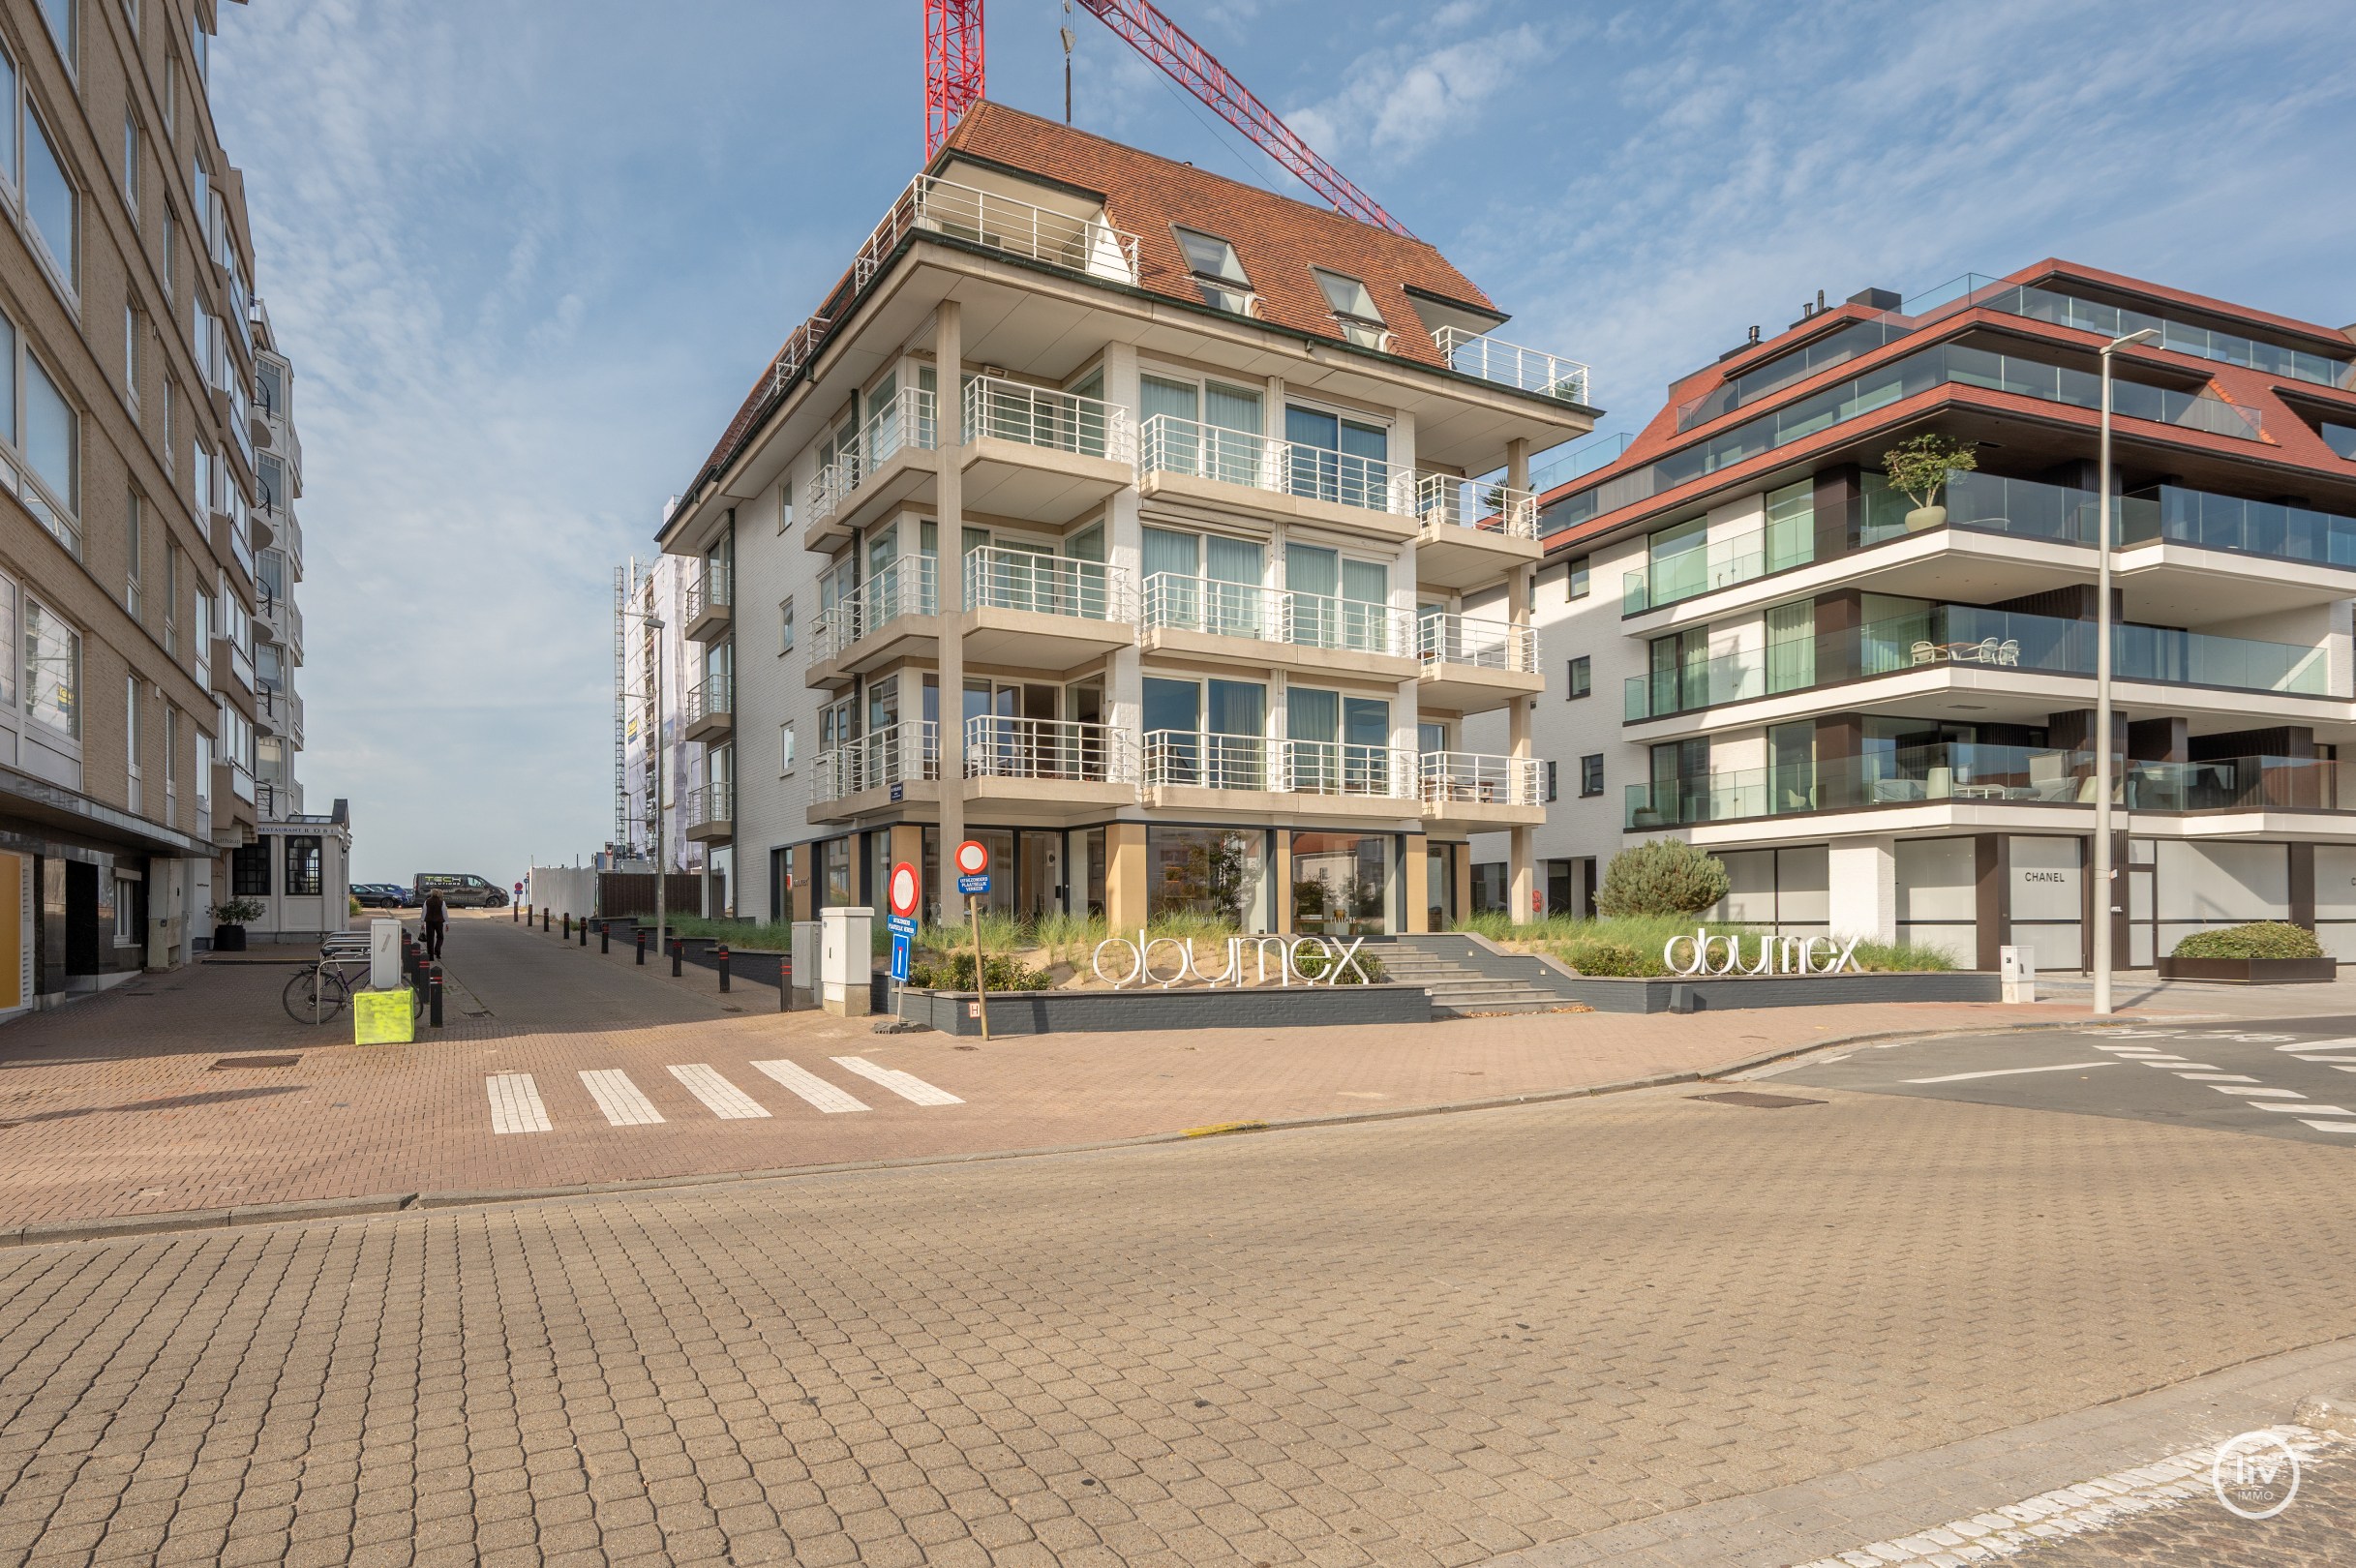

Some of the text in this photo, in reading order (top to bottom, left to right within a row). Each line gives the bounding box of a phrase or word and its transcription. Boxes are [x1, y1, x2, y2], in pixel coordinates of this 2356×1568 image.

[2024, 872, 2066, 883] CHANEL
[1092, 929, 1370, 988] obumex
[1663, 927, 1863, 976] obumex
[971, 1005, 979, 1015] H
